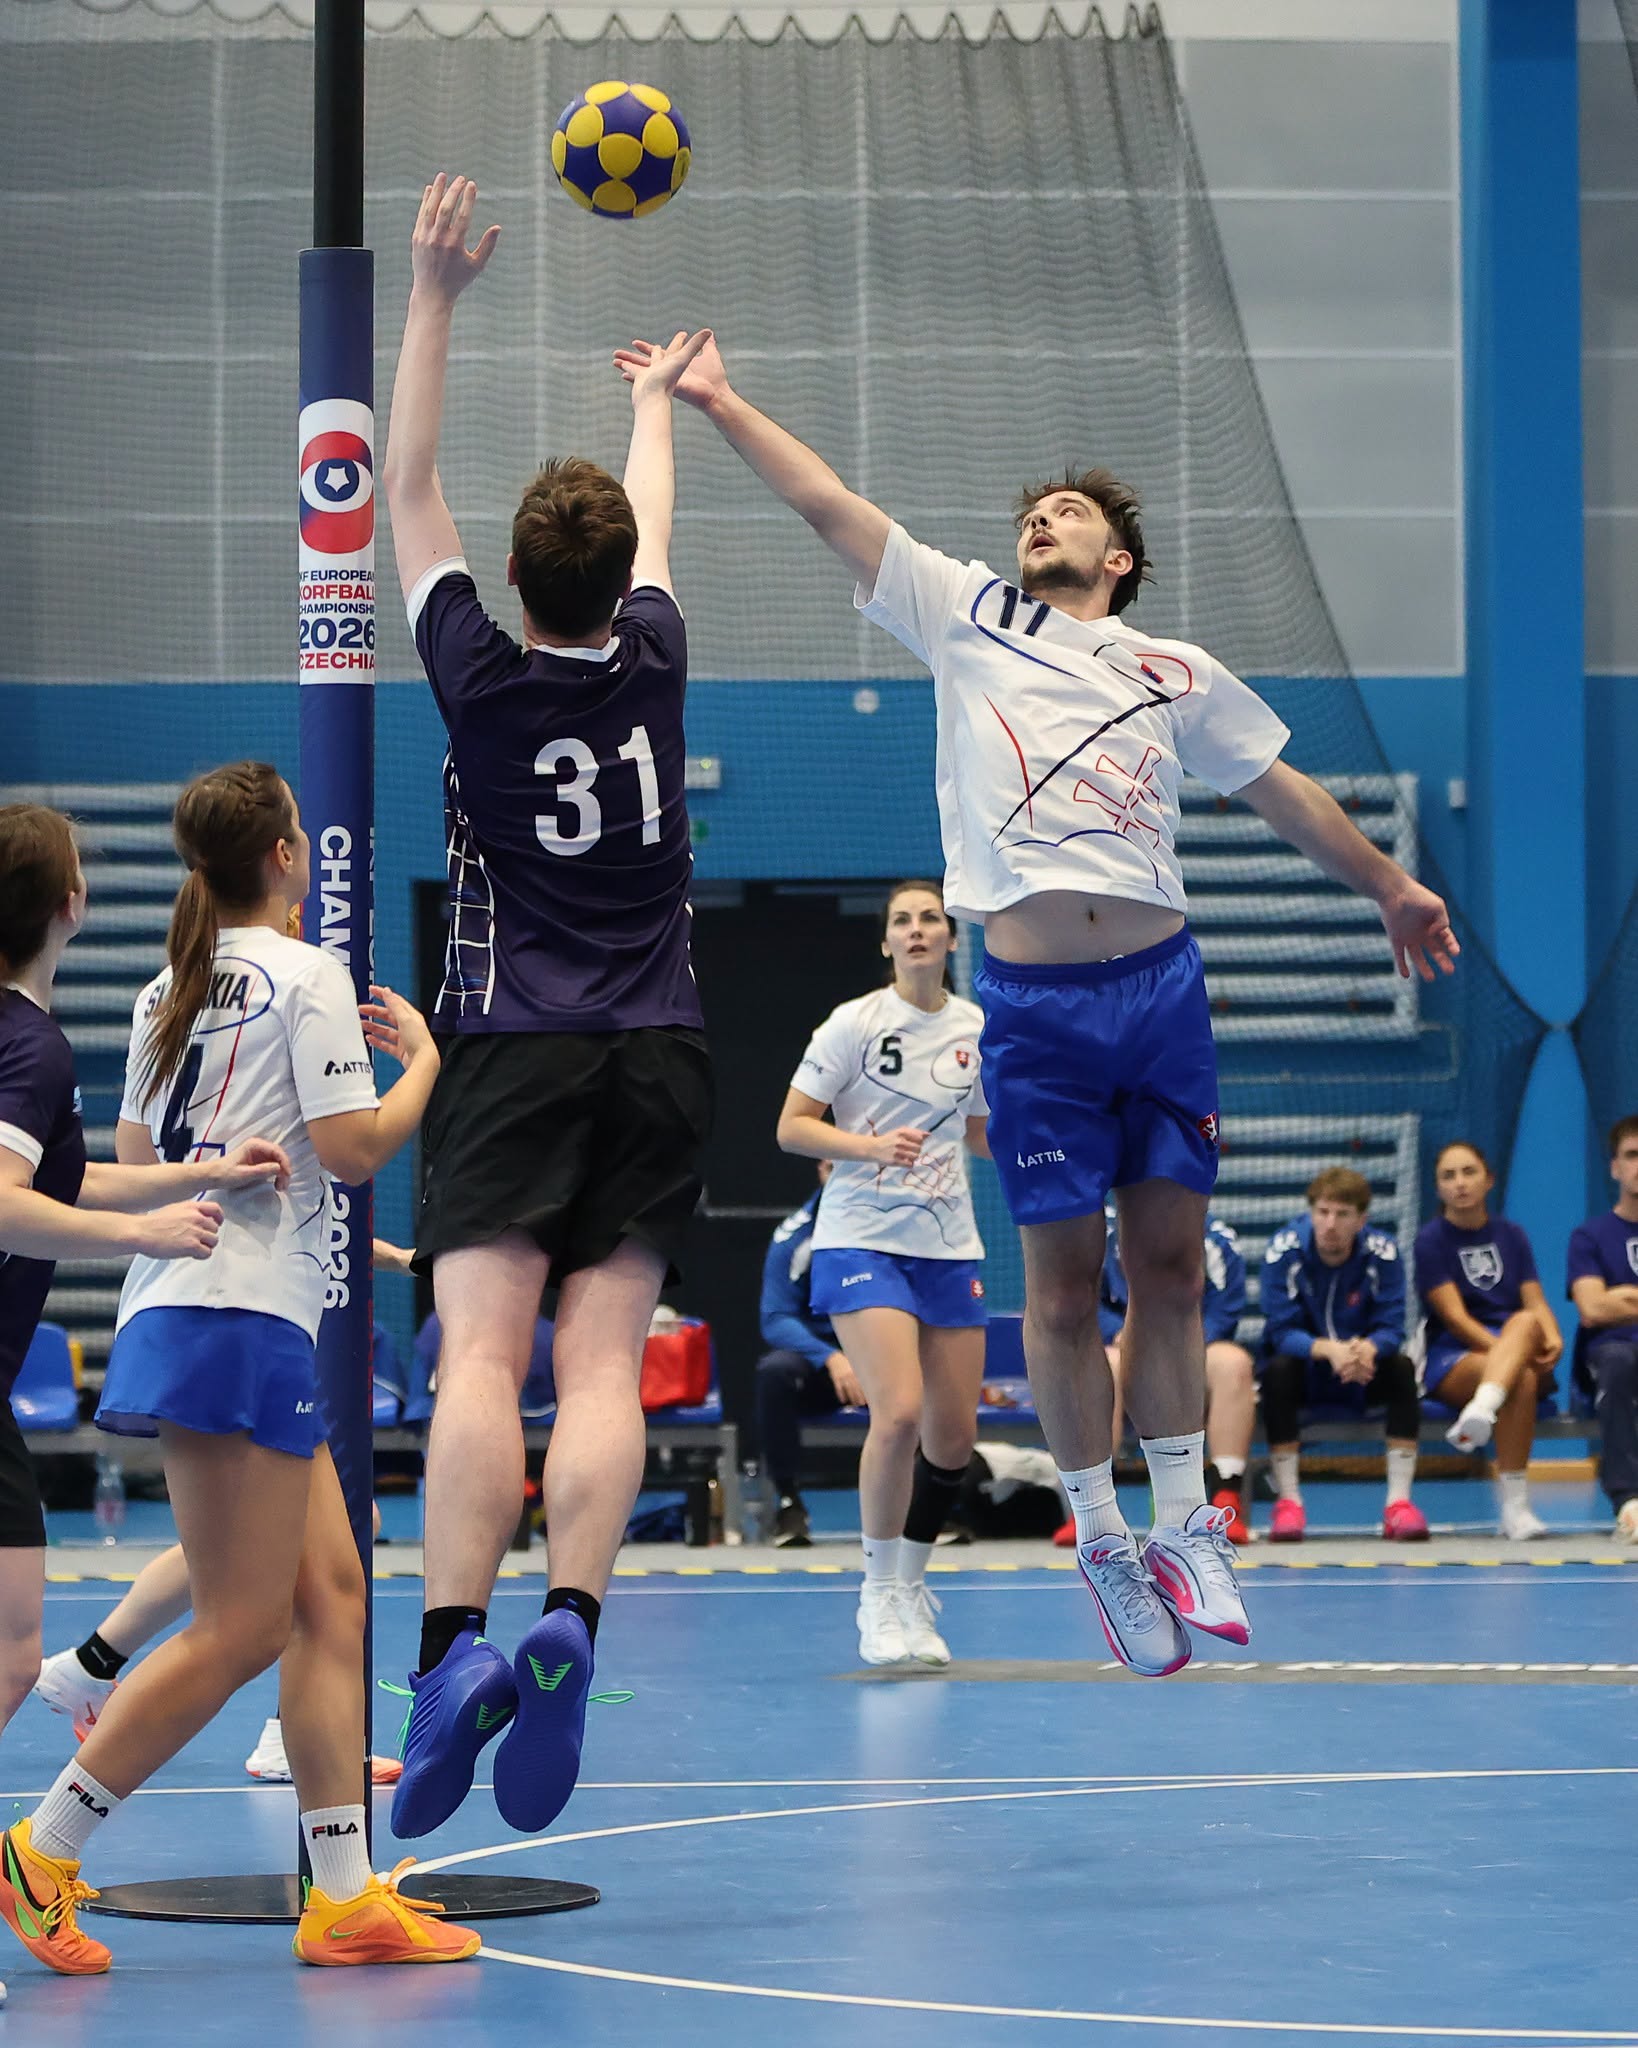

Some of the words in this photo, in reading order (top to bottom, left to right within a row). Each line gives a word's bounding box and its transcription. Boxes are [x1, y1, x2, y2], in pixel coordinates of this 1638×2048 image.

[998, 585, 1052, 637] 17
[300, 618, 374, 650] 2026
[534, 725, 662, 856] 31
[879, 1036, 902, 1075] 5
[160, 1043, 204, 1163] 4
[1027, 1149, 1065, 1167] ATTIS
[68, 1781, 109, 1818] FILA
[312, 1822, 358, 1839] FILA
